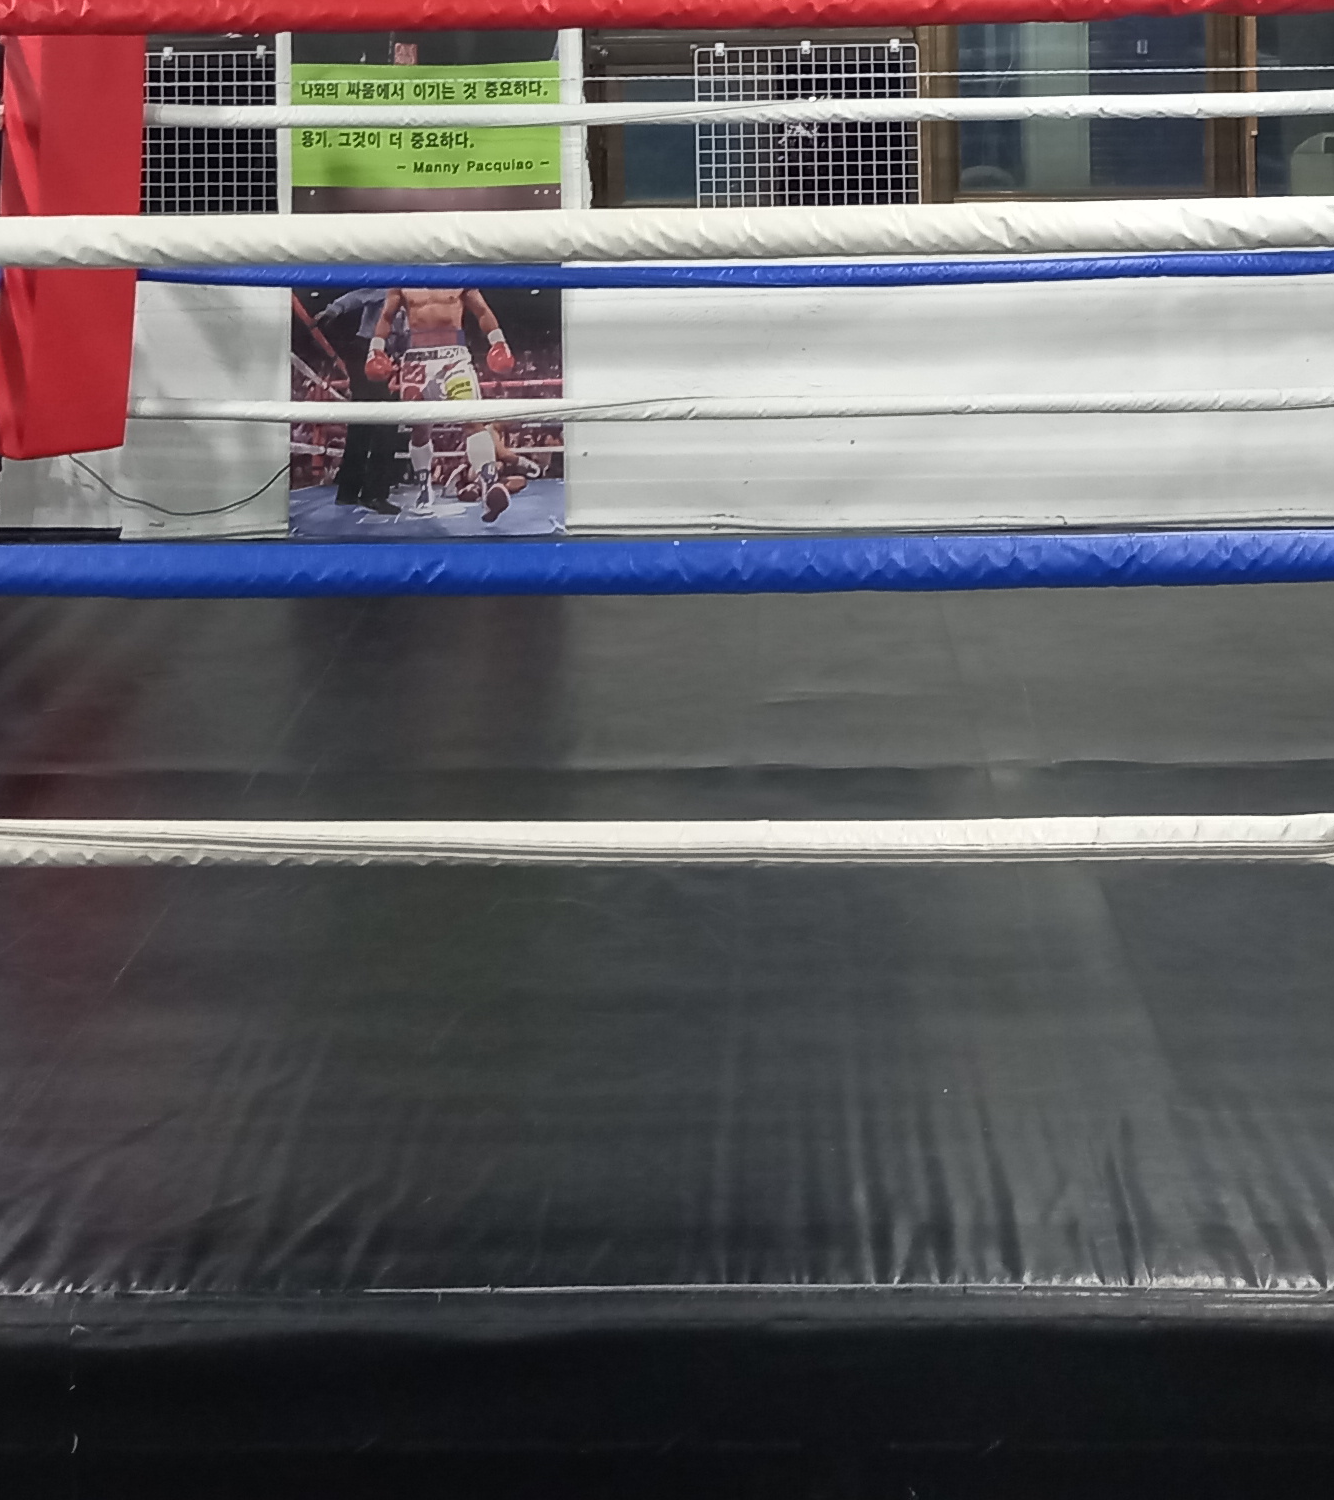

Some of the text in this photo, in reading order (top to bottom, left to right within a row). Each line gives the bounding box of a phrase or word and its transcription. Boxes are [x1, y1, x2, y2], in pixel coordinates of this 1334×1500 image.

[301, 80, 548, 100] 나와의 싸움에서 이기는 것 중요하다.
[338, 131, 381, 148] 그것이
[389, 132, 403, 149] 더
[411, 131, 474, 149] 중요하다.
[413, 161, 460, 174] Manny
[467, 158, 534, 173] Pacquiao
